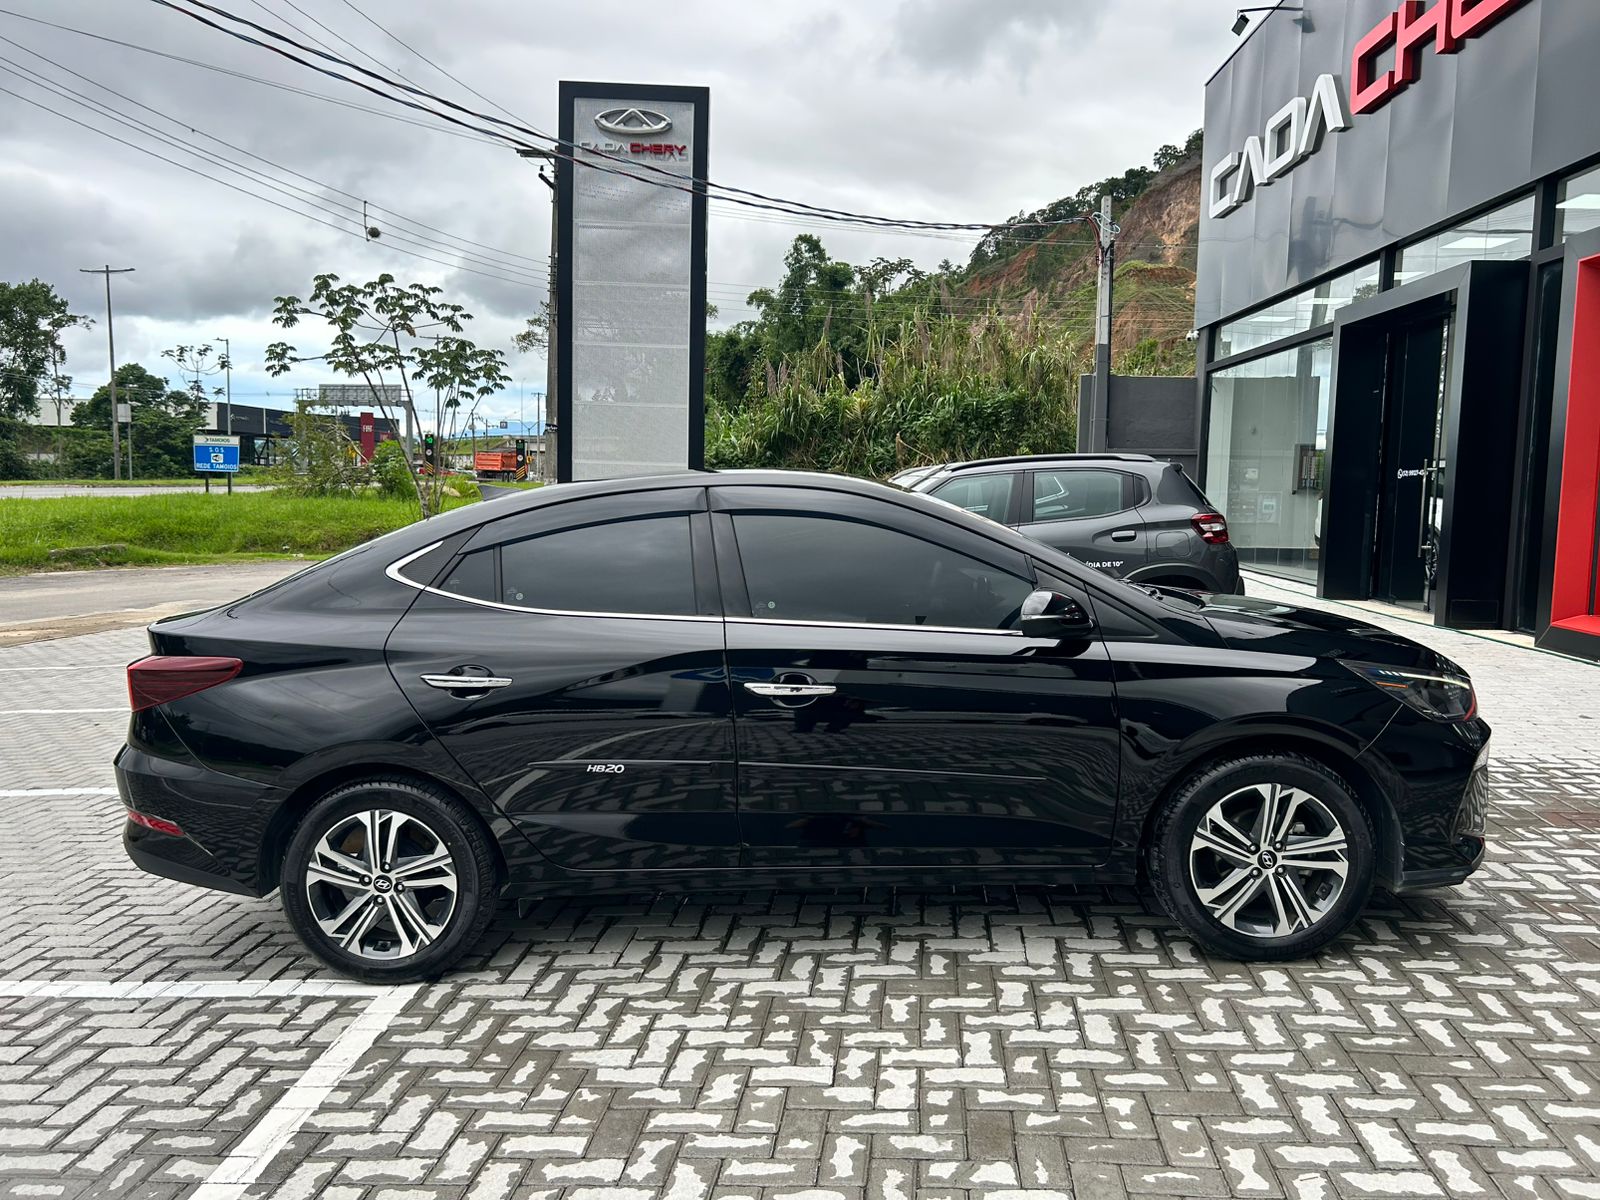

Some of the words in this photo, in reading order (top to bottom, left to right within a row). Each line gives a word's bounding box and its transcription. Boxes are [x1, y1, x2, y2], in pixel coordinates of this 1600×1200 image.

[630, 142, 687, 155] CHERY
[1209, 73, 1346, 219] CAOA
[586, 764, 625, 774] HB20
